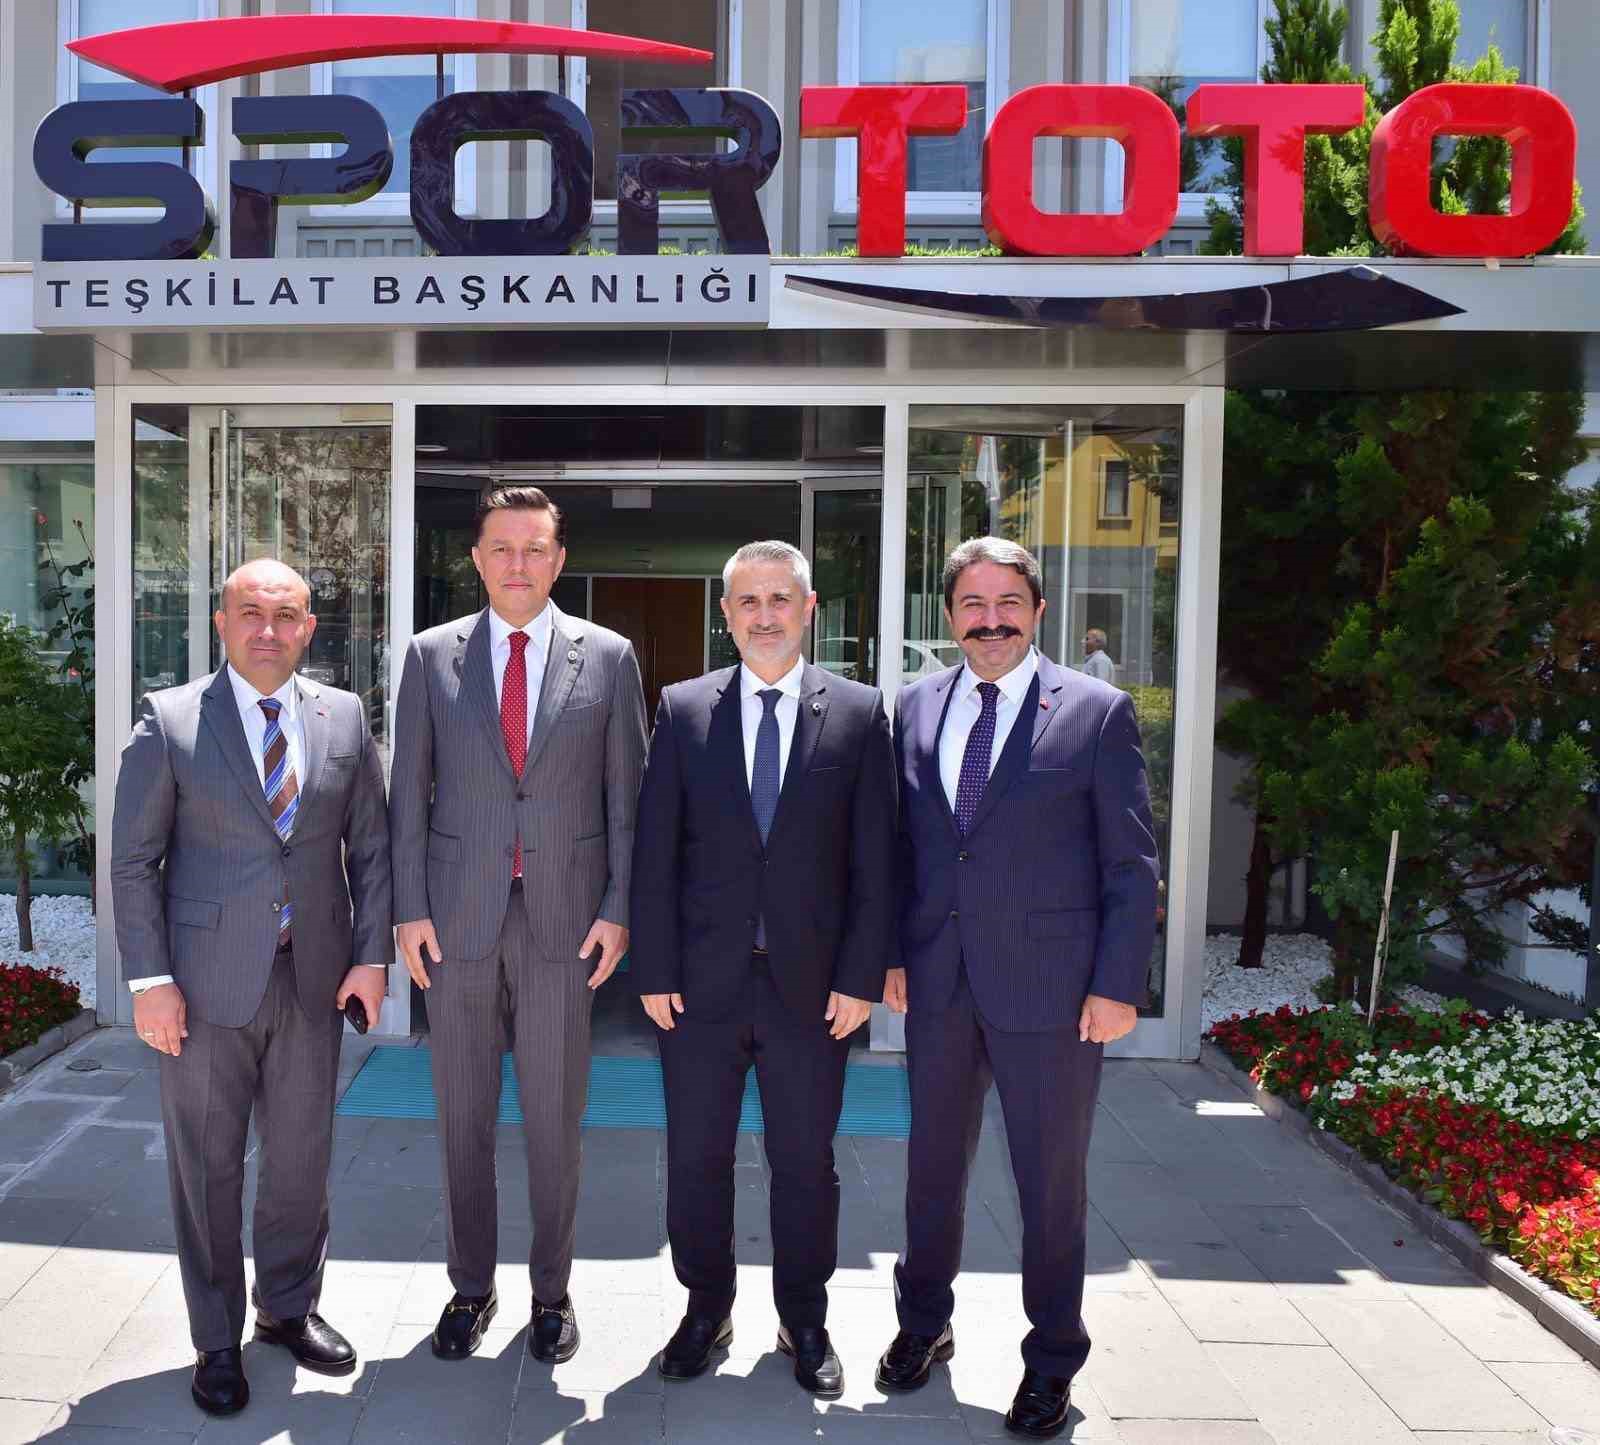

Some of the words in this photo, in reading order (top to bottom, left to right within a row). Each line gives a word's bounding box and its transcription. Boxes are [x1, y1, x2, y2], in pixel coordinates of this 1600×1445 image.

[33, 87, 783, 260] SPOR
[800, 83, 1577, 257] TOTO
[47, 270, 335, 314] TEŞKİLAT
[373, 267, 758, 311] BAŞKANLIĞI
